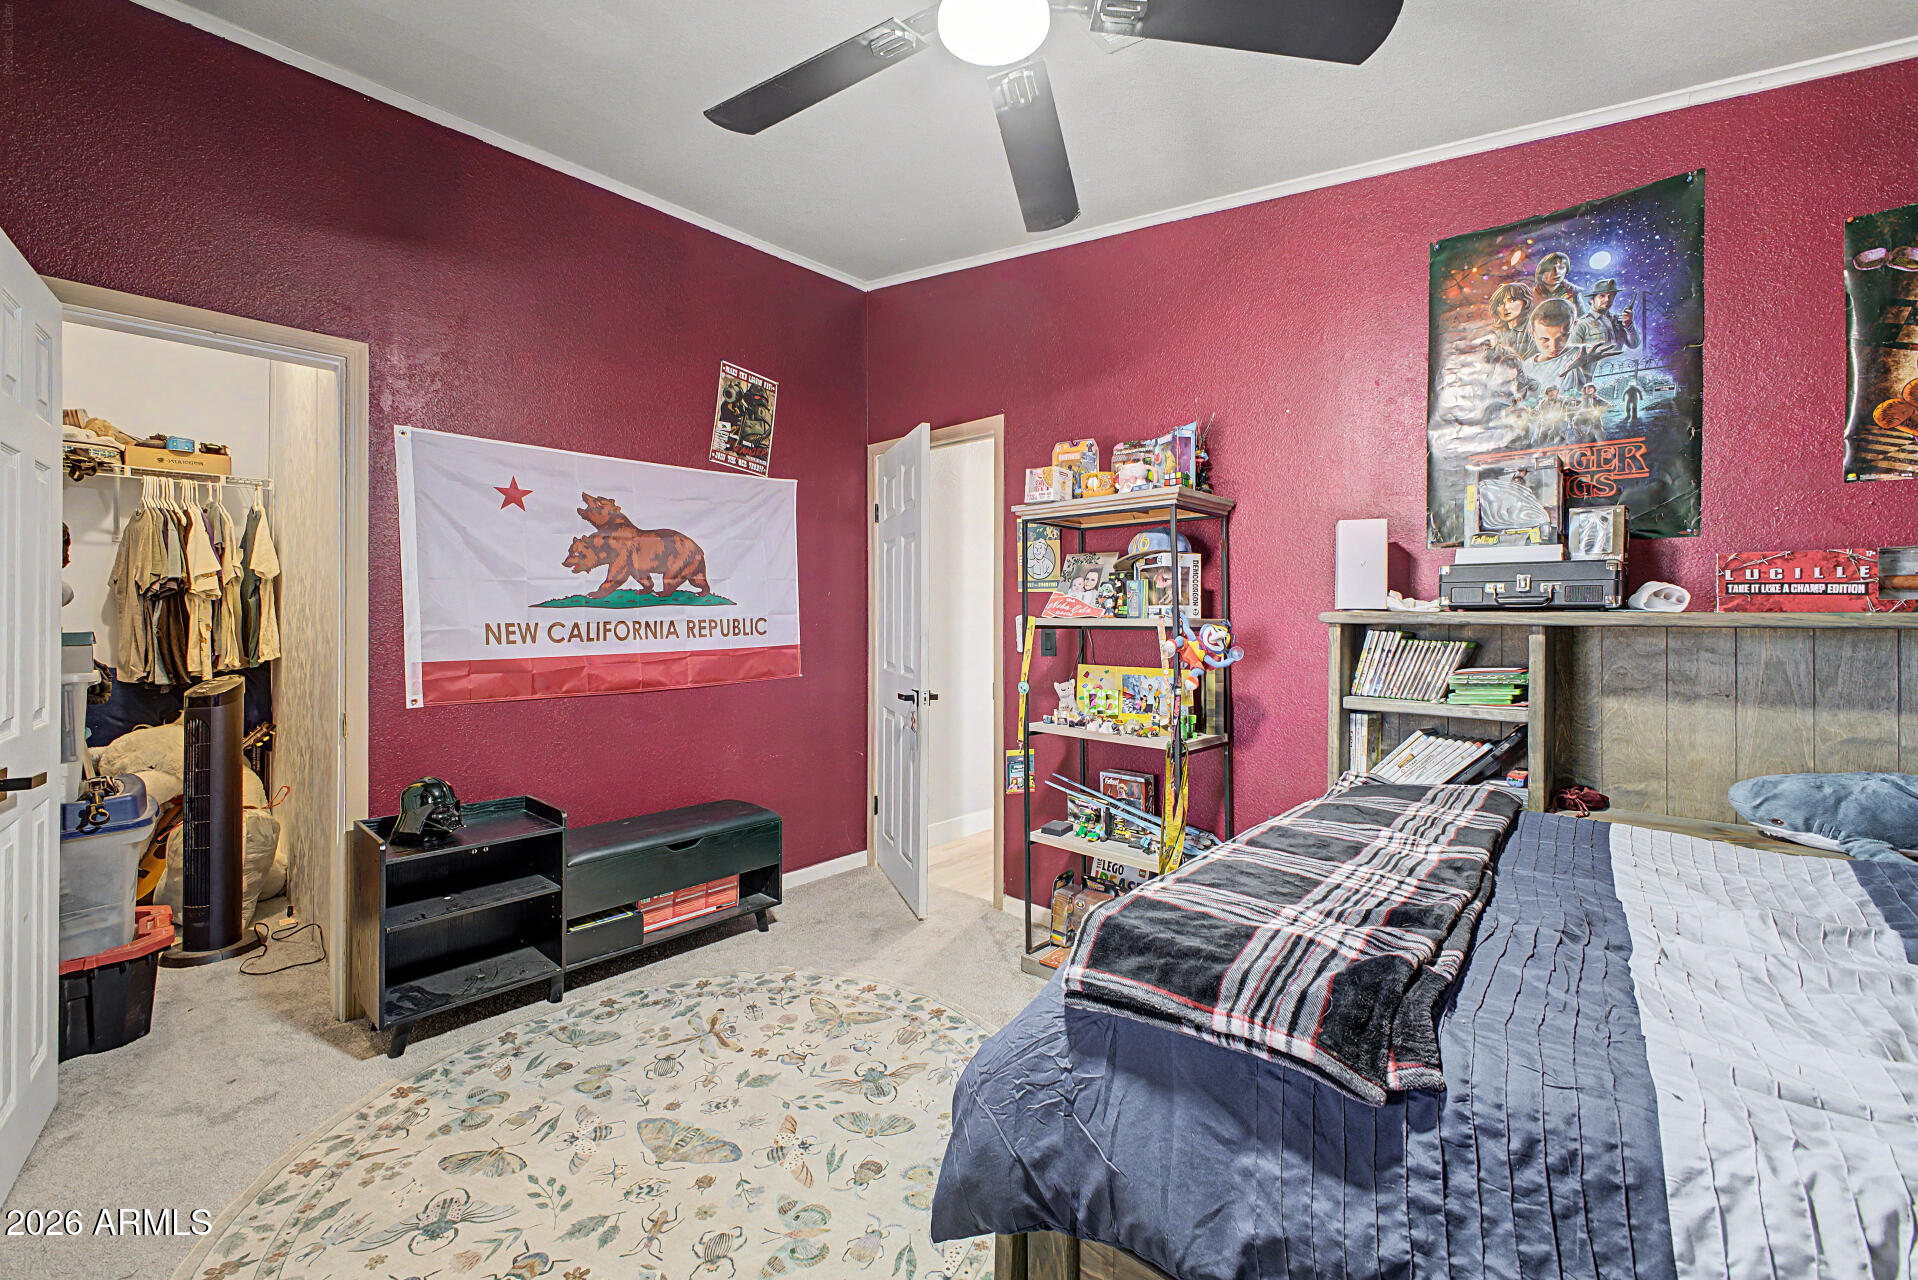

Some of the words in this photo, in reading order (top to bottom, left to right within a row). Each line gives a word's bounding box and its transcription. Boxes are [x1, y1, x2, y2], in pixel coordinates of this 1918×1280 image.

[1725, 565, 1871, 581] LUCILLE
[1727, 583, 1750, 594] TAKE
[1750, 583, 1760, 594] IT
[1761, 583, 1782, 594] LIKE
[1782, 583, 1790, 593] A
[1790, 583, 1826, 594] CHAMP
[1827, 583, 1866, 594] EDITION
[485, 622, 539, 646] NEW
[547, 620, 680, 644] CALIFORNIA
[686, 617, 768, 639] REPUBLIC
[1101, 860, 1125, 876] LEGO
